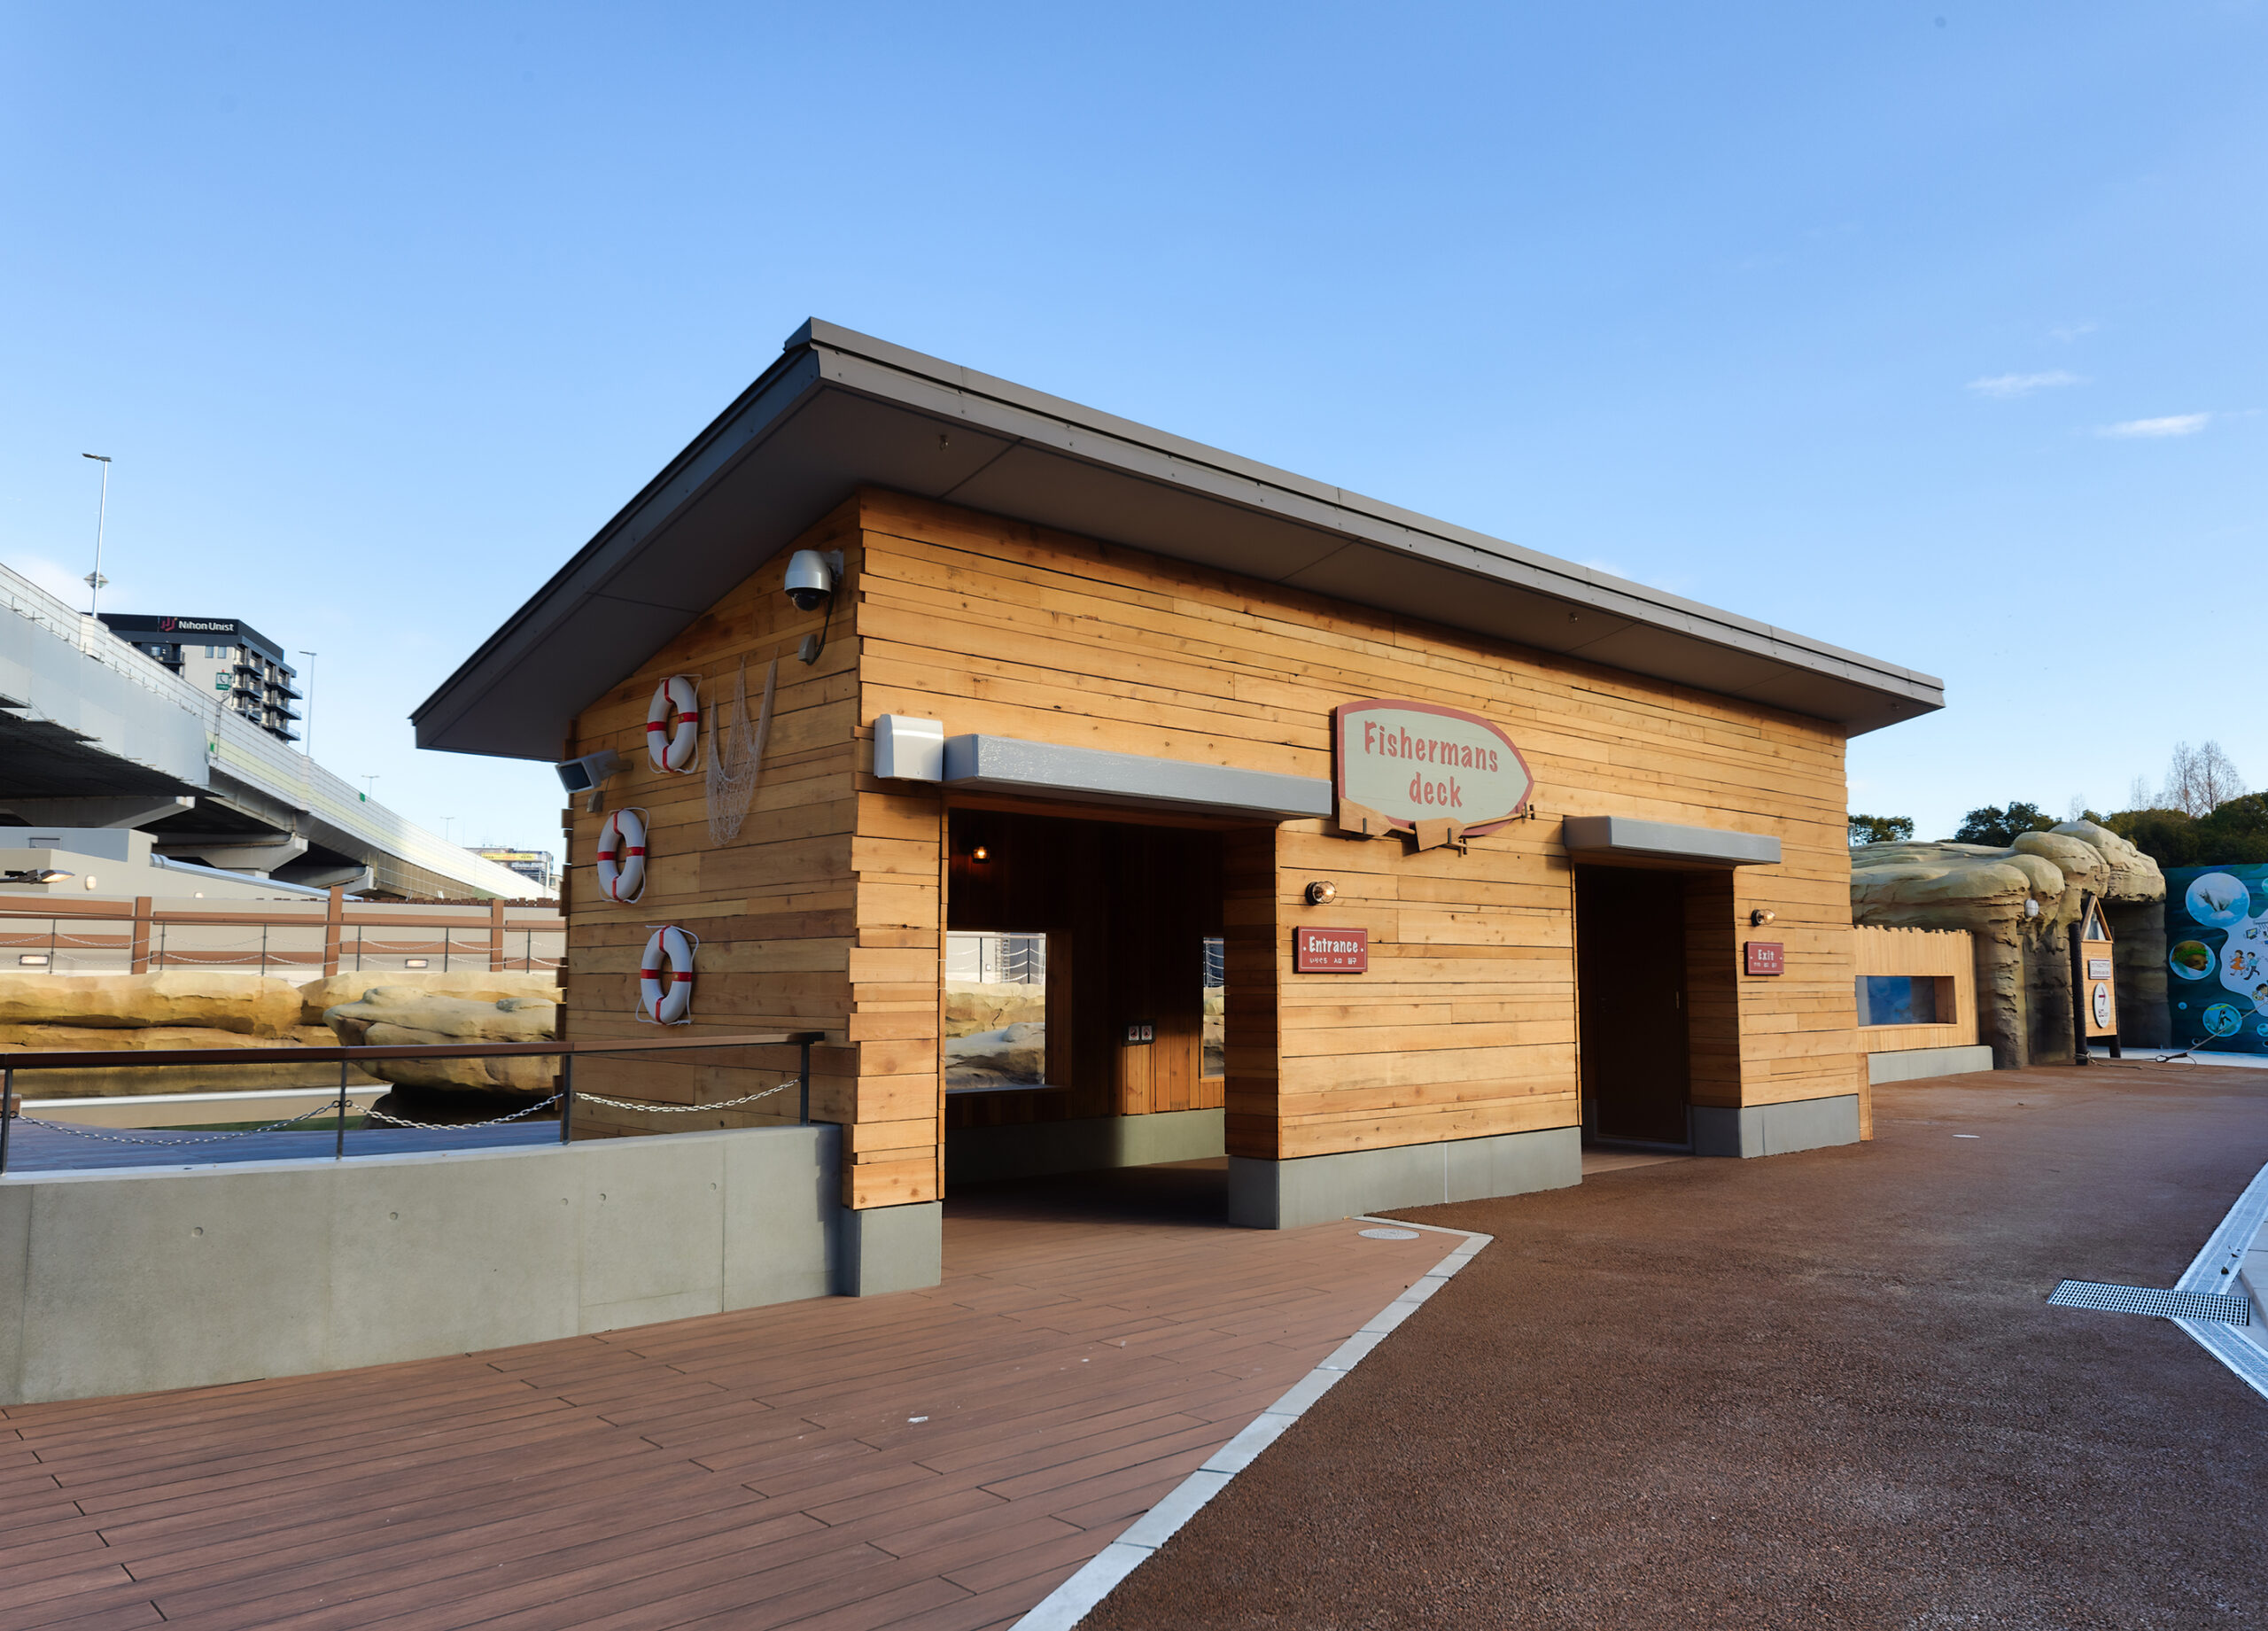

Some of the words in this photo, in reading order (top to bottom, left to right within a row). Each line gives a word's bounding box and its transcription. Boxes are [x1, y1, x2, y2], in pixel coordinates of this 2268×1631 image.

[178, 620, 208, 631] Nihon
[209, 622, 235, 632] Unist
[1363, 719, 1499, 773] Fishermans
[1409, 771, 1463, 808] deck
[1309, 936, 1359, 954] Entrance
[1758, 949, 1775, 961] Exit
